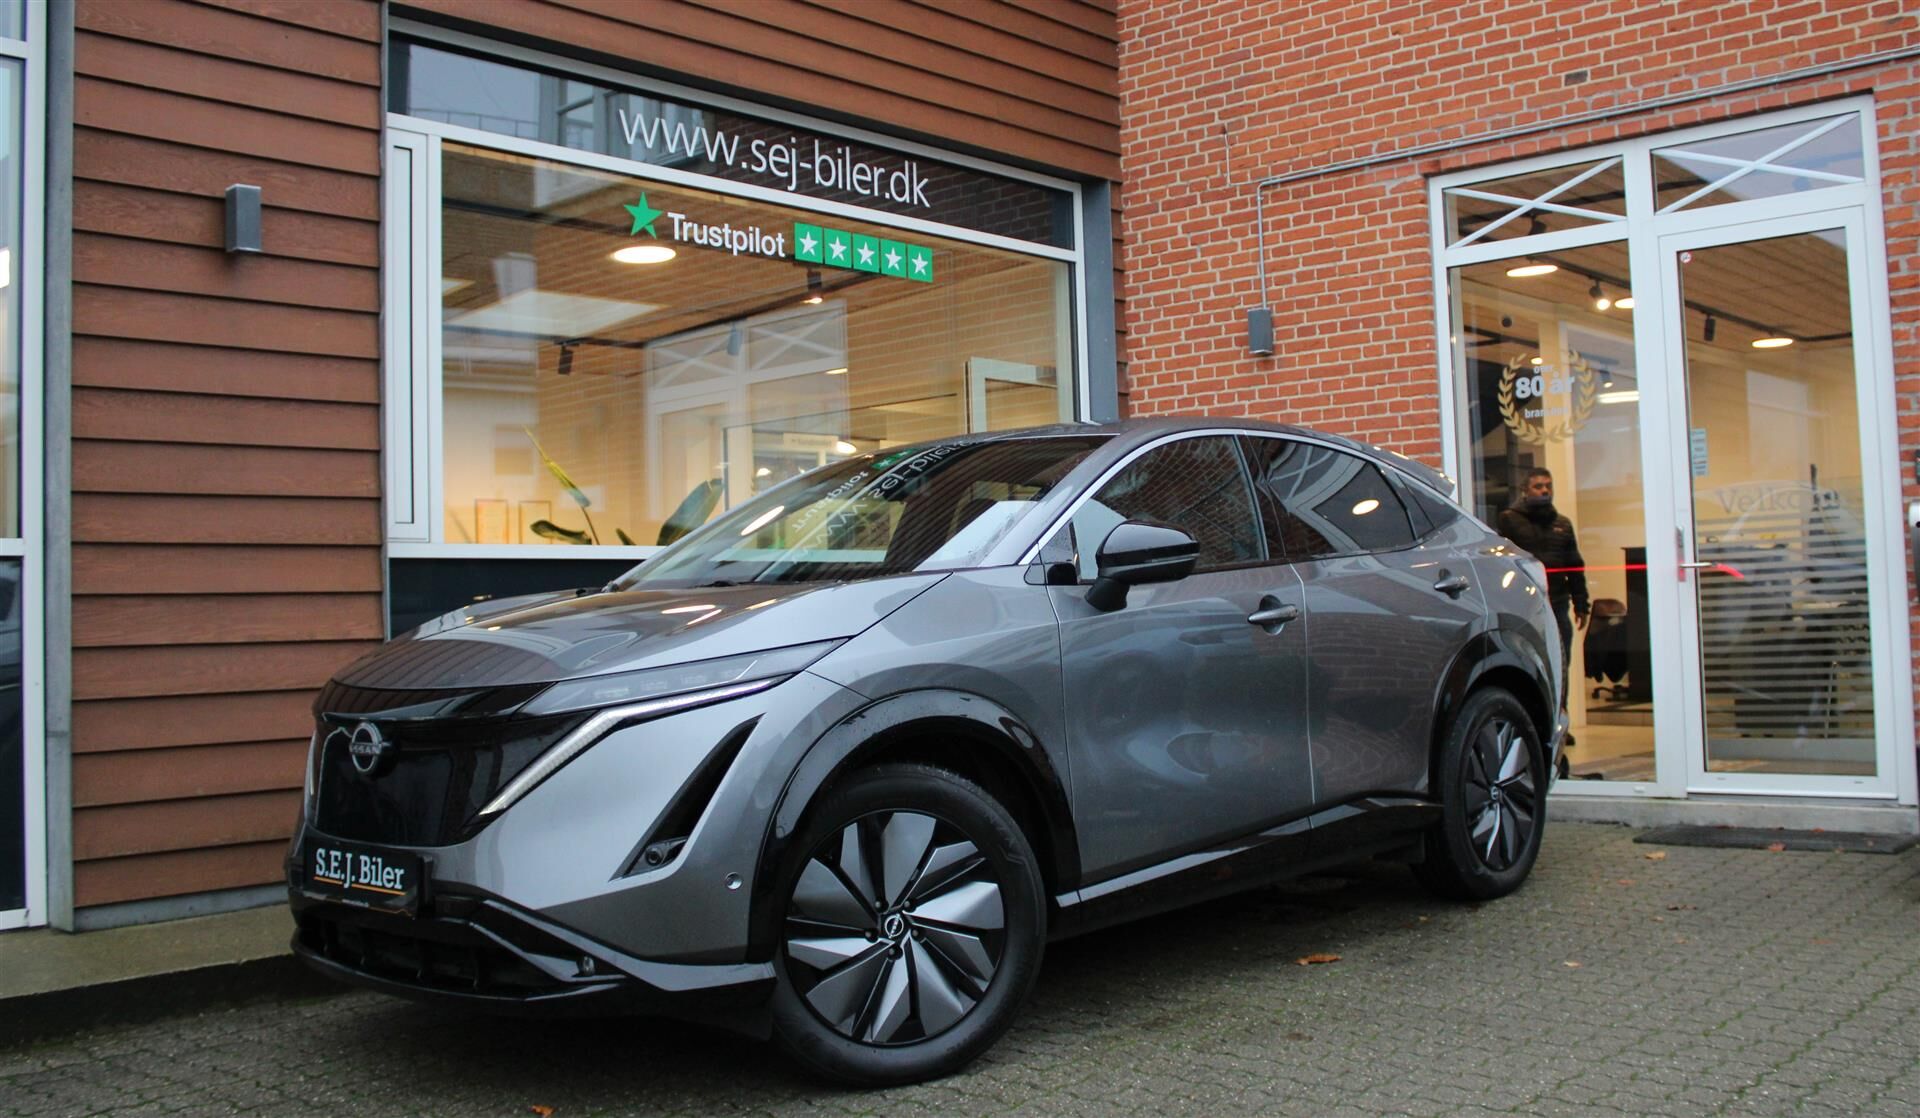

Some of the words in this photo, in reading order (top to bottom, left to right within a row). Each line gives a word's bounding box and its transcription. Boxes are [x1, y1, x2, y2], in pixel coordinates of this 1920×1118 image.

[617, 108, 932, 208] www.sej-biler.dk
[667, 211, 786, 258] Trustpilot
[1515, 375, 1545, 399] 80
[1549, 371, 1576, 394] år
[315, 848, 355, 889] S.E.J.
[359, 855, 405, 890] Biler
